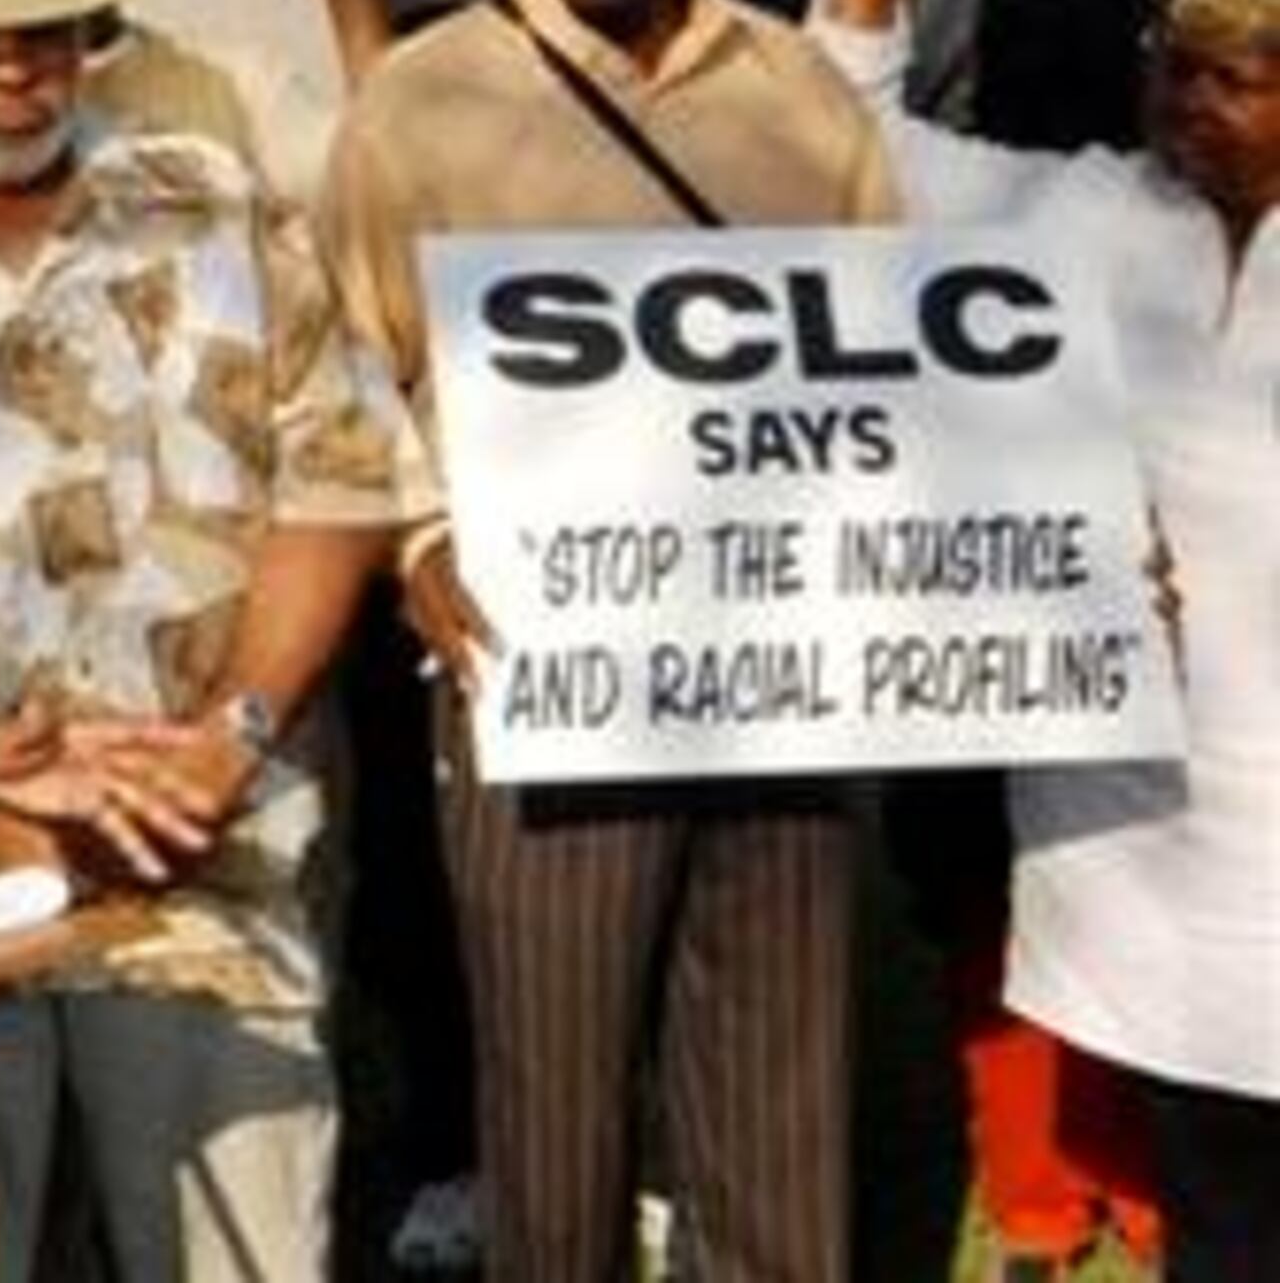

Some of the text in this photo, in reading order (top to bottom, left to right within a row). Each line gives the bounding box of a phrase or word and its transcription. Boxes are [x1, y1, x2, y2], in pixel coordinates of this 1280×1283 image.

[480, 264, 1063, 390] SCLC
[689, 407, 896, 478] SAYS
[711, 519, 805, 601] THE
[835, 513, 1091, 595] INJUSTICE
[502, 646, 622, 731] AND
[648, 635, 838, 727] RACIAL
